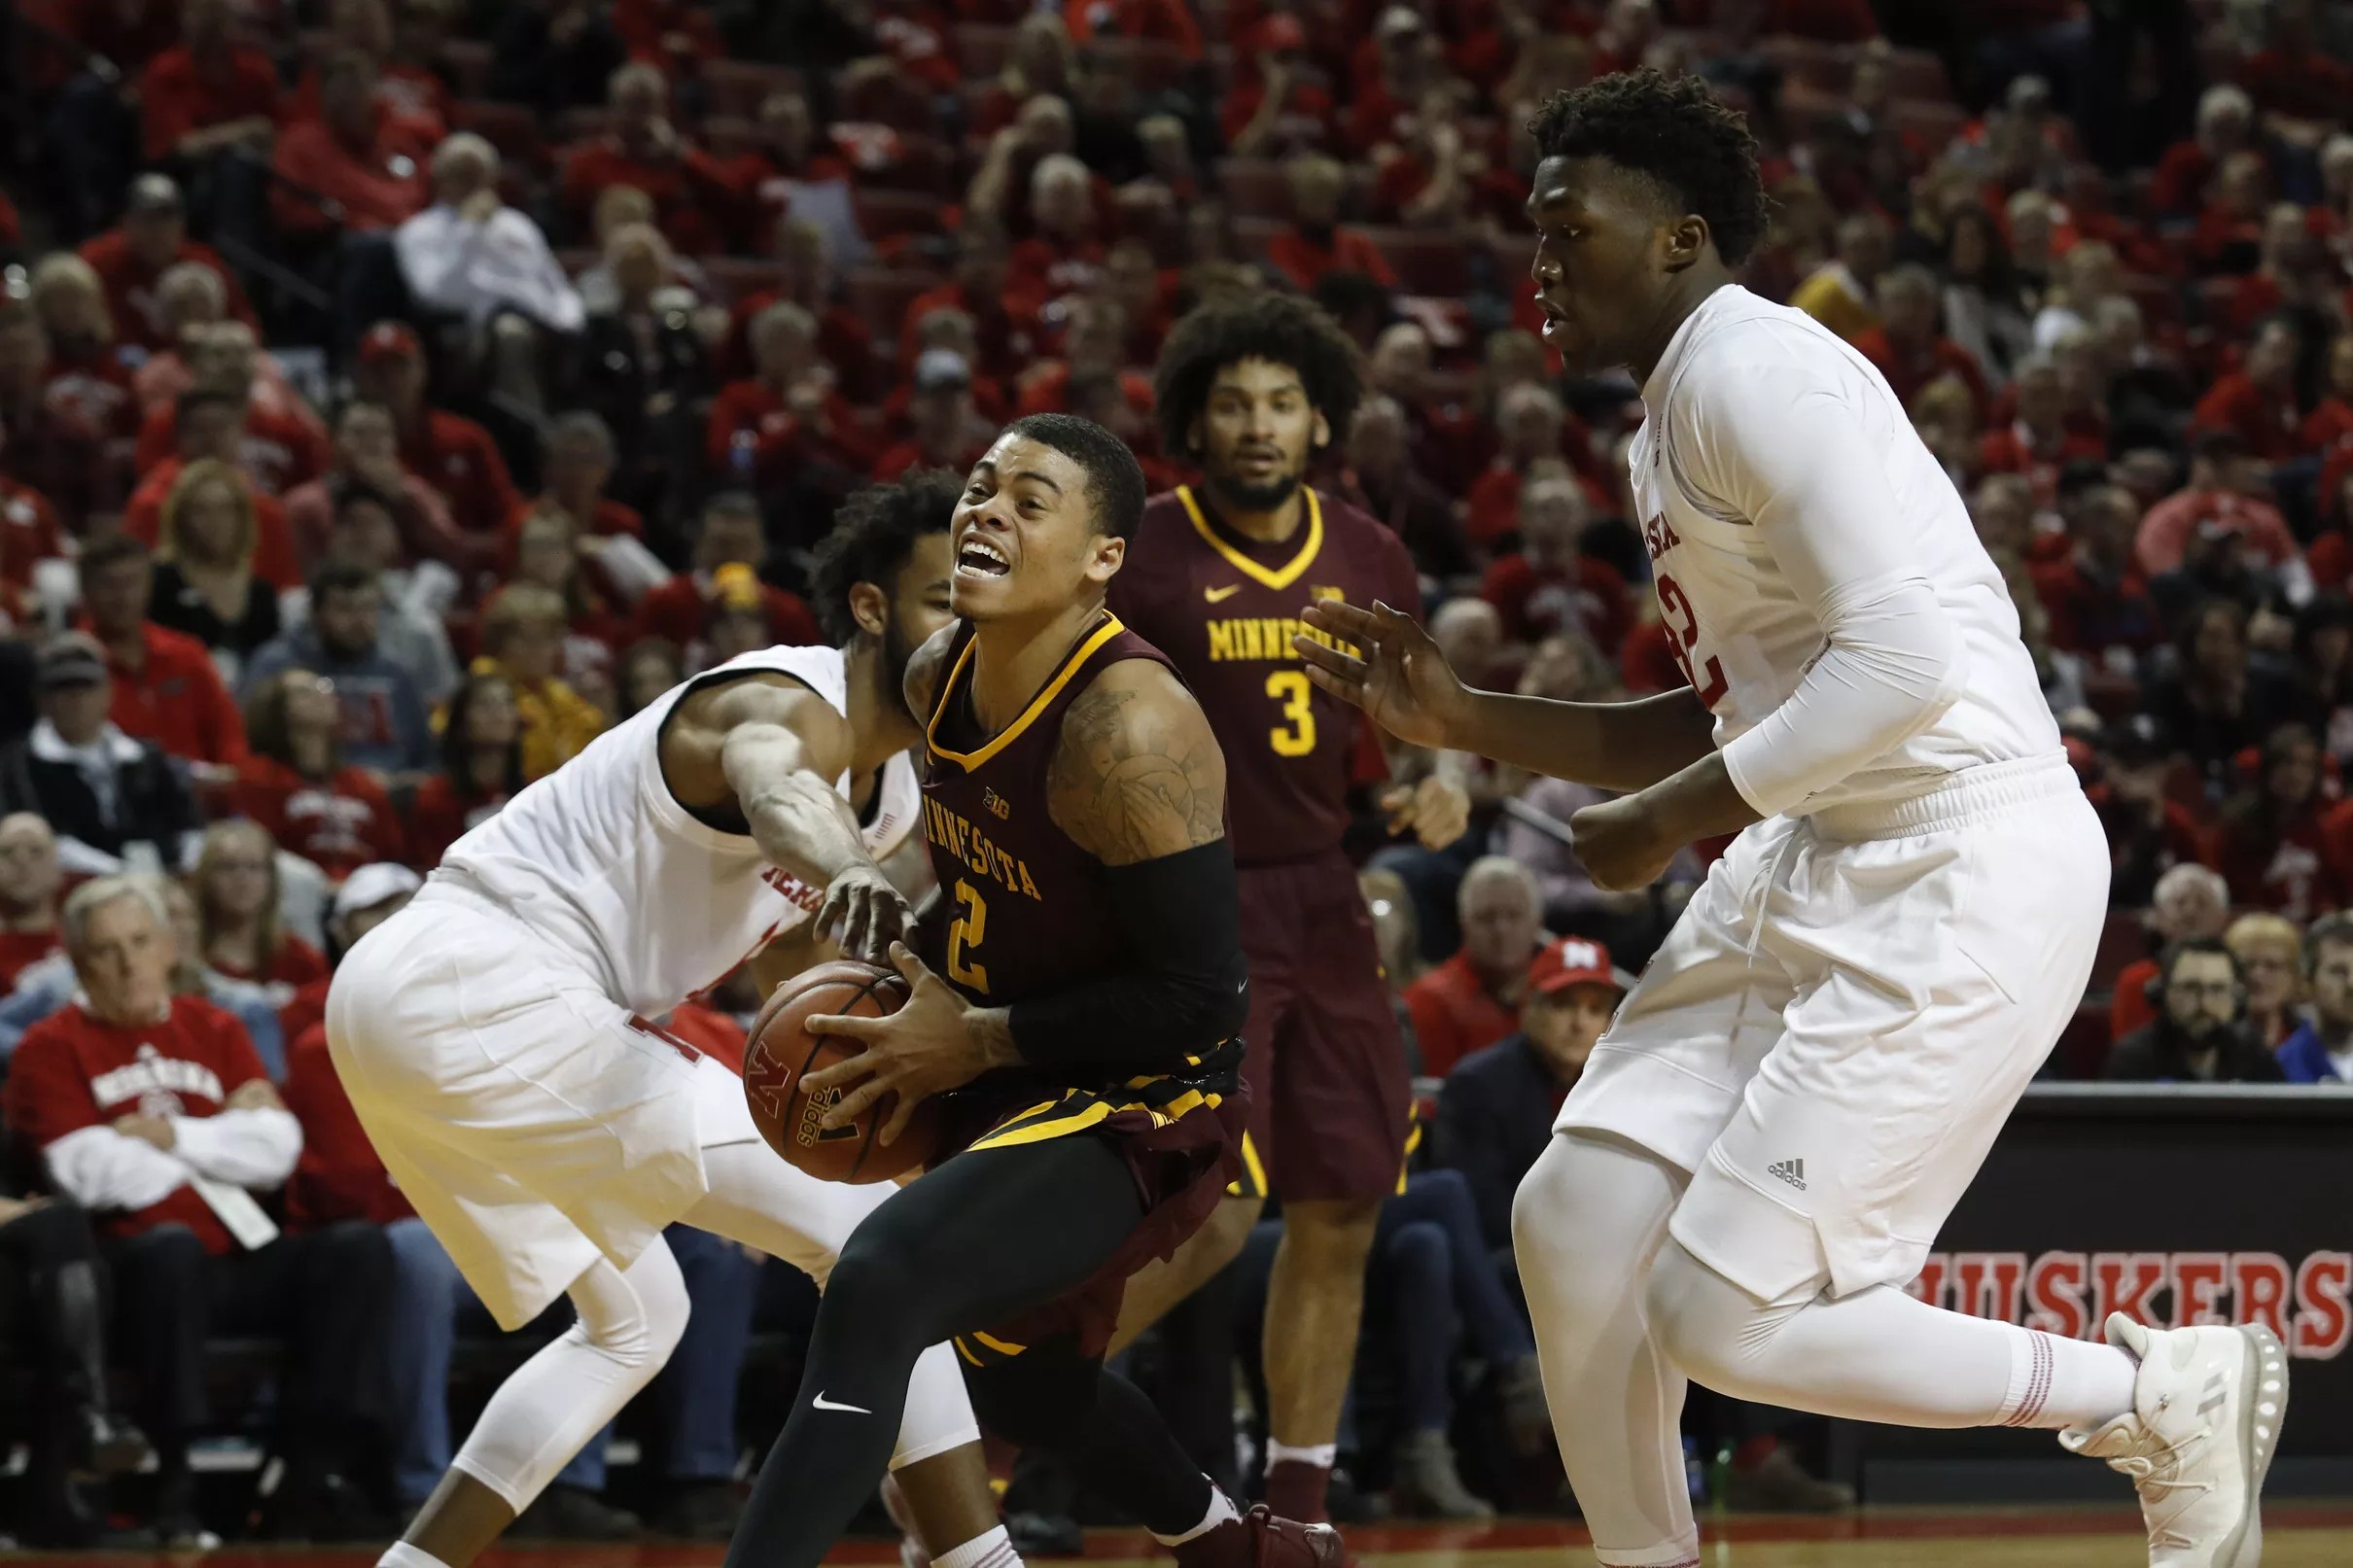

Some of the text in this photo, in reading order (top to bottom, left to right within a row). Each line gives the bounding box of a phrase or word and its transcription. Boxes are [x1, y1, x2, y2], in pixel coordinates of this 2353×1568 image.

[1207, 616, 1362, 662] MINNE
[1265, 670, 1316, 757] 3
[923, 793, 1042, 902] INNESOTA
[947, 877, 991, 995] 2
[797, 1086, 831, 1148] didas
[1768, 1165, 1807, 1191] adidas
